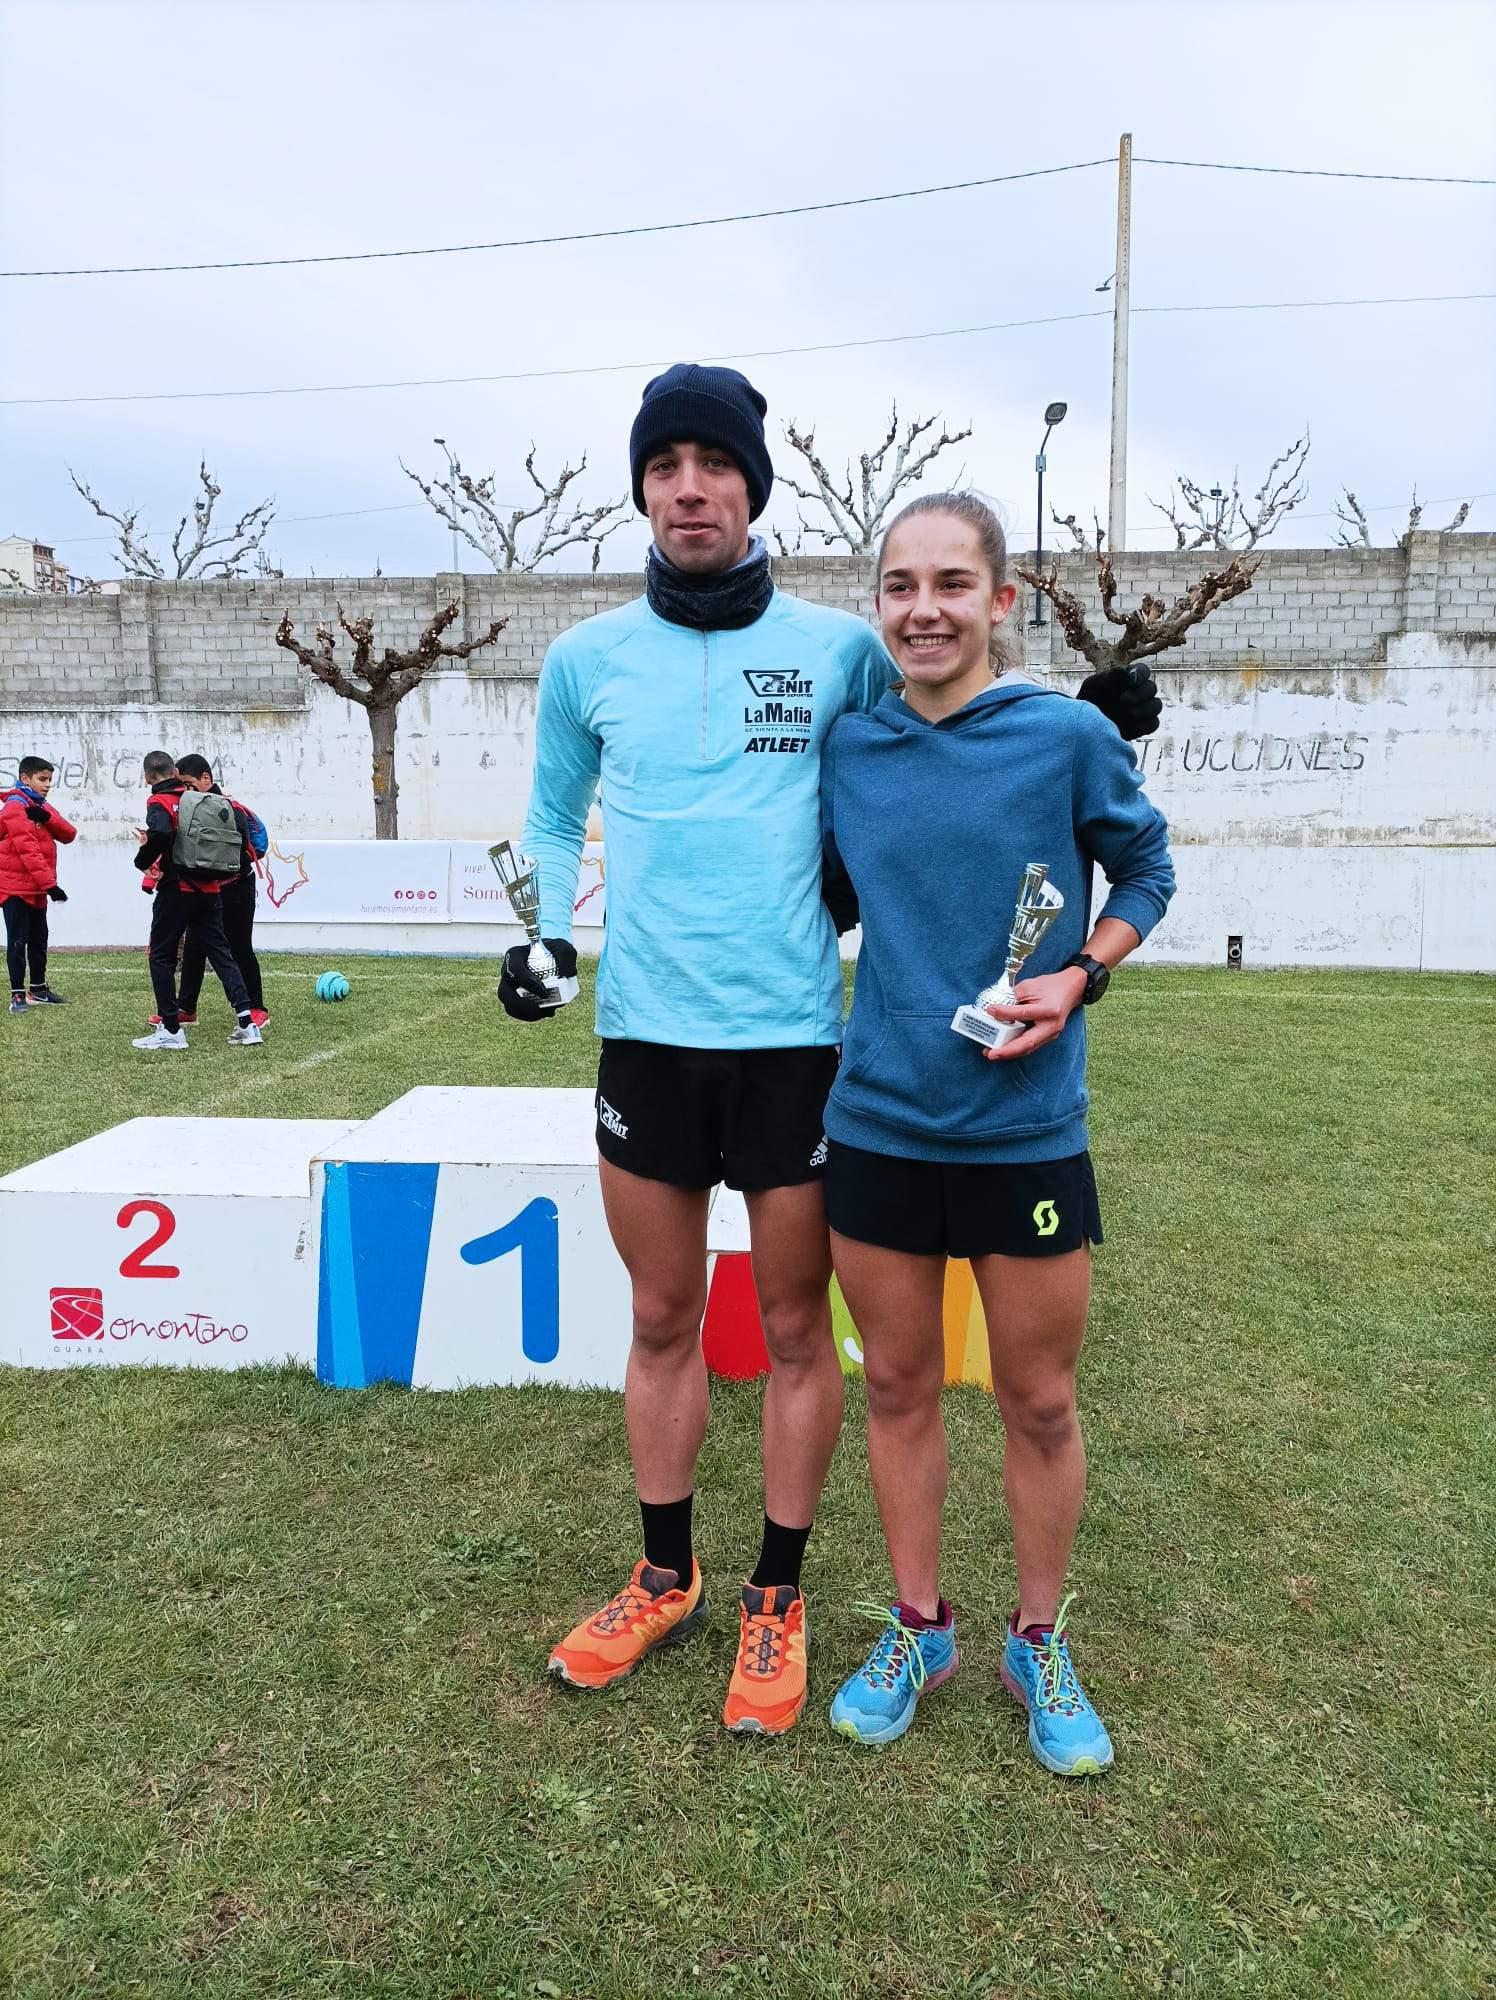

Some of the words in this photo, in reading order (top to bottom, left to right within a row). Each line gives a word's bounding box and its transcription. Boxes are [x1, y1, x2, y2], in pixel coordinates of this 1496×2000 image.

[756, 673, 813, 693] ZENIT
[744, 737, 811, 753] ATLEET
[116, 1199, 181, 1279] 2
[460, 1196, 560, 1364] 1
